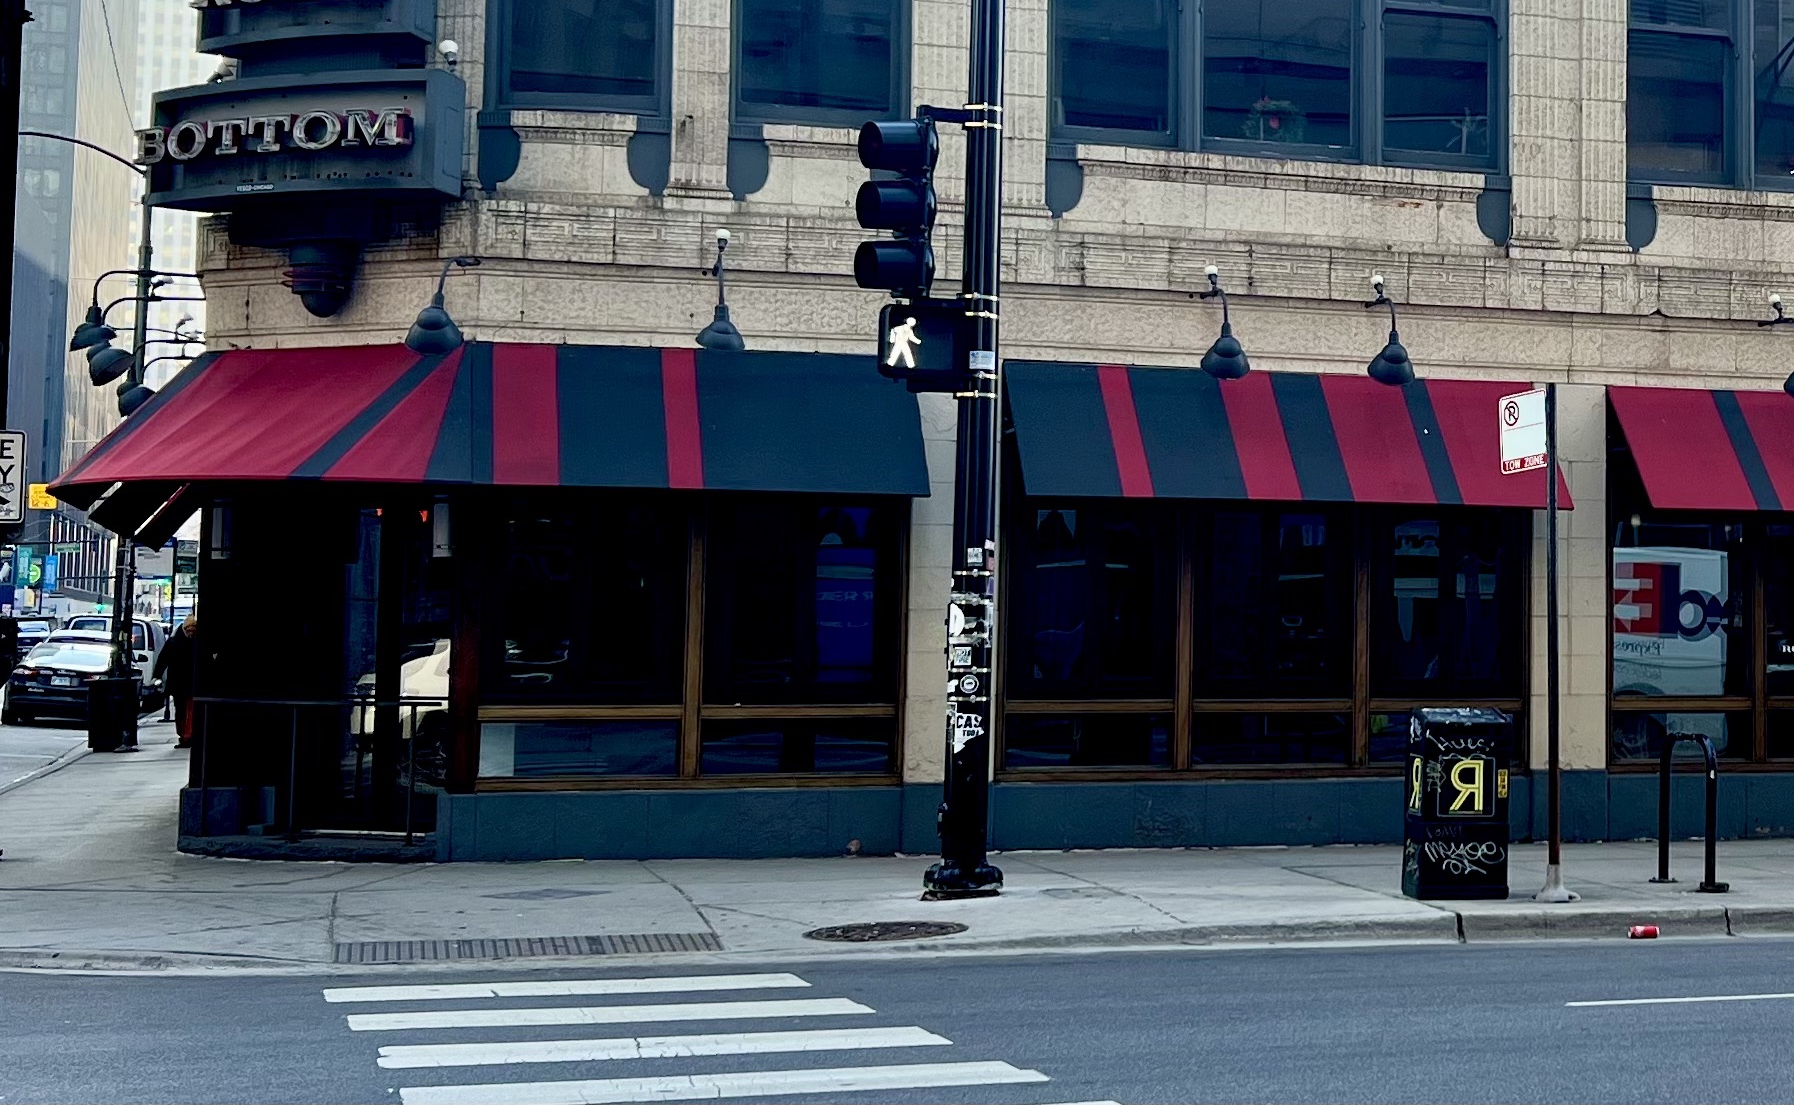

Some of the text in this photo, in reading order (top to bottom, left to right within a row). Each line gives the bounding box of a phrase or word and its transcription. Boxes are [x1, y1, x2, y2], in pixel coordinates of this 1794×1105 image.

[133, 106, 412, 164] BOTTOM
[1504, 453, 1545, 471] TOW ZONE
